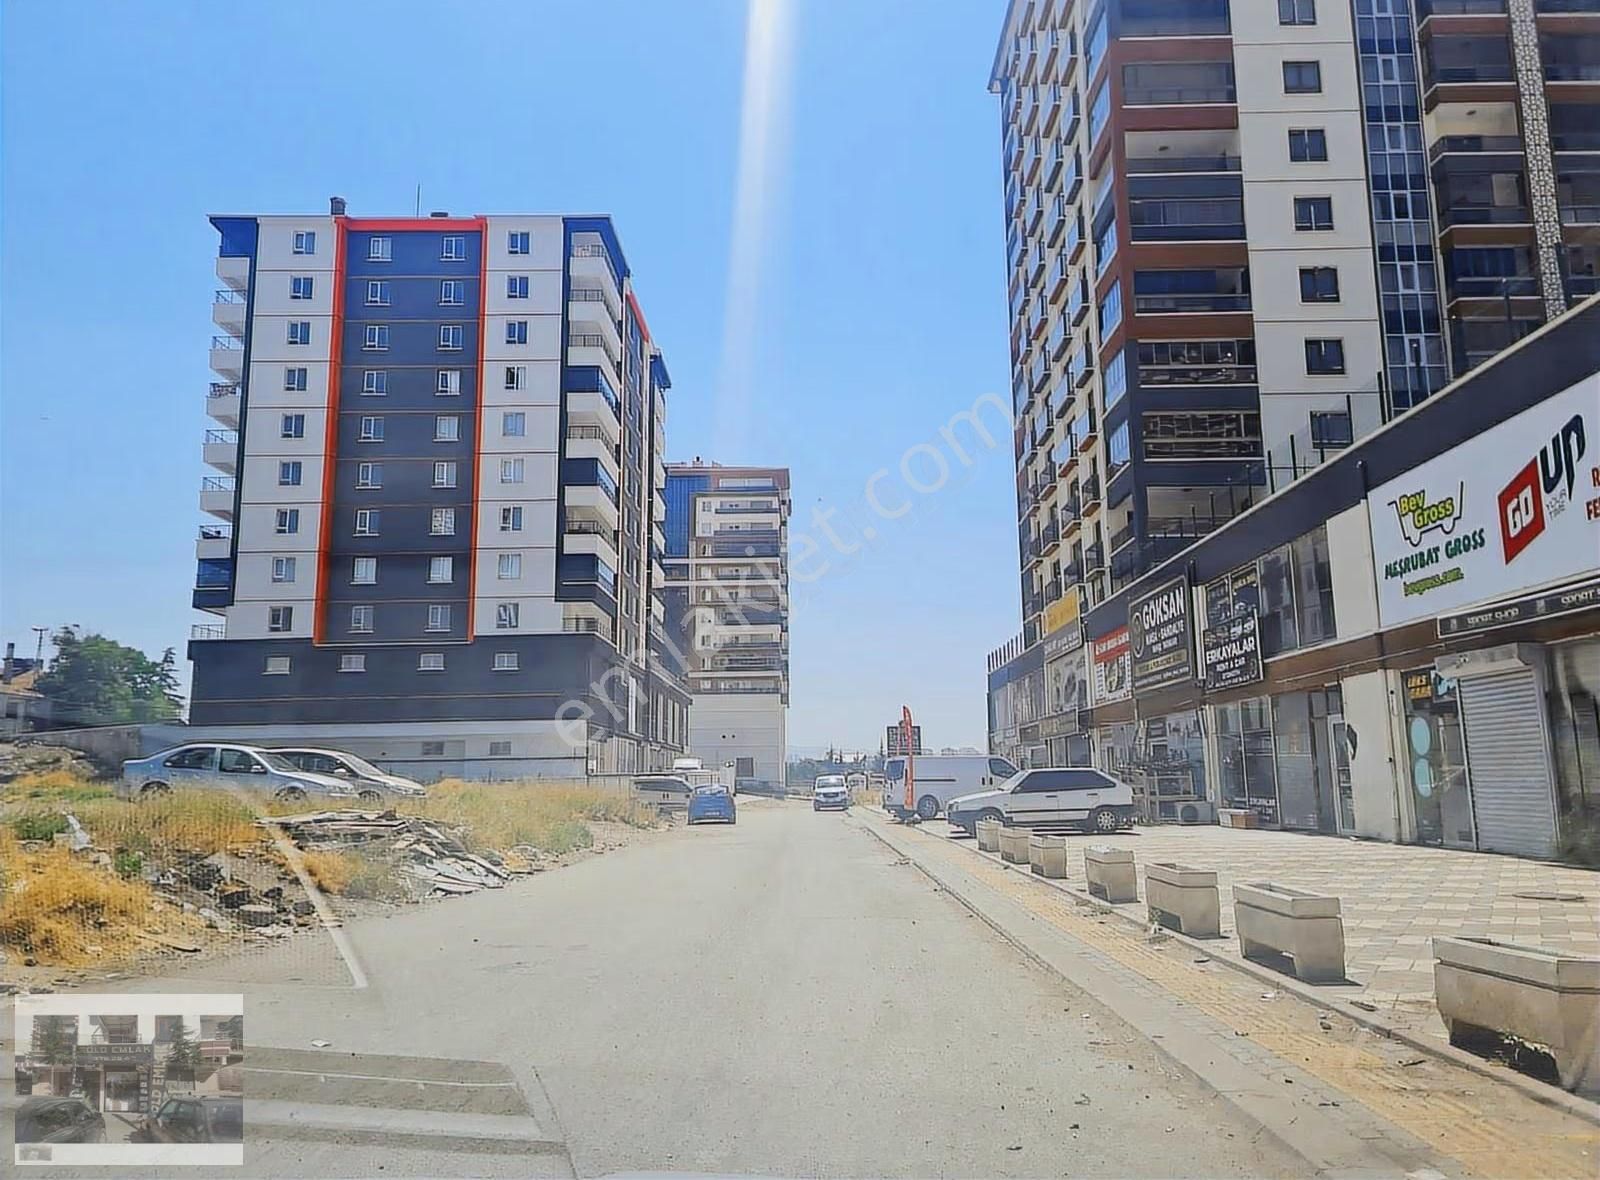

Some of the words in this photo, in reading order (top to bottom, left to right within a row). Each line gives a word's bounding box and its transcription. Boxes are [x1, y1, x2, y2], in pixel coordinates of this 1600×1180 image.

[1507, 484, 1534, 539] GO
[1539, 414, 1586, 501] UP
[1413, 497, 1454, 529] Gross
[1445, 528, 1485, 559] GROSS
